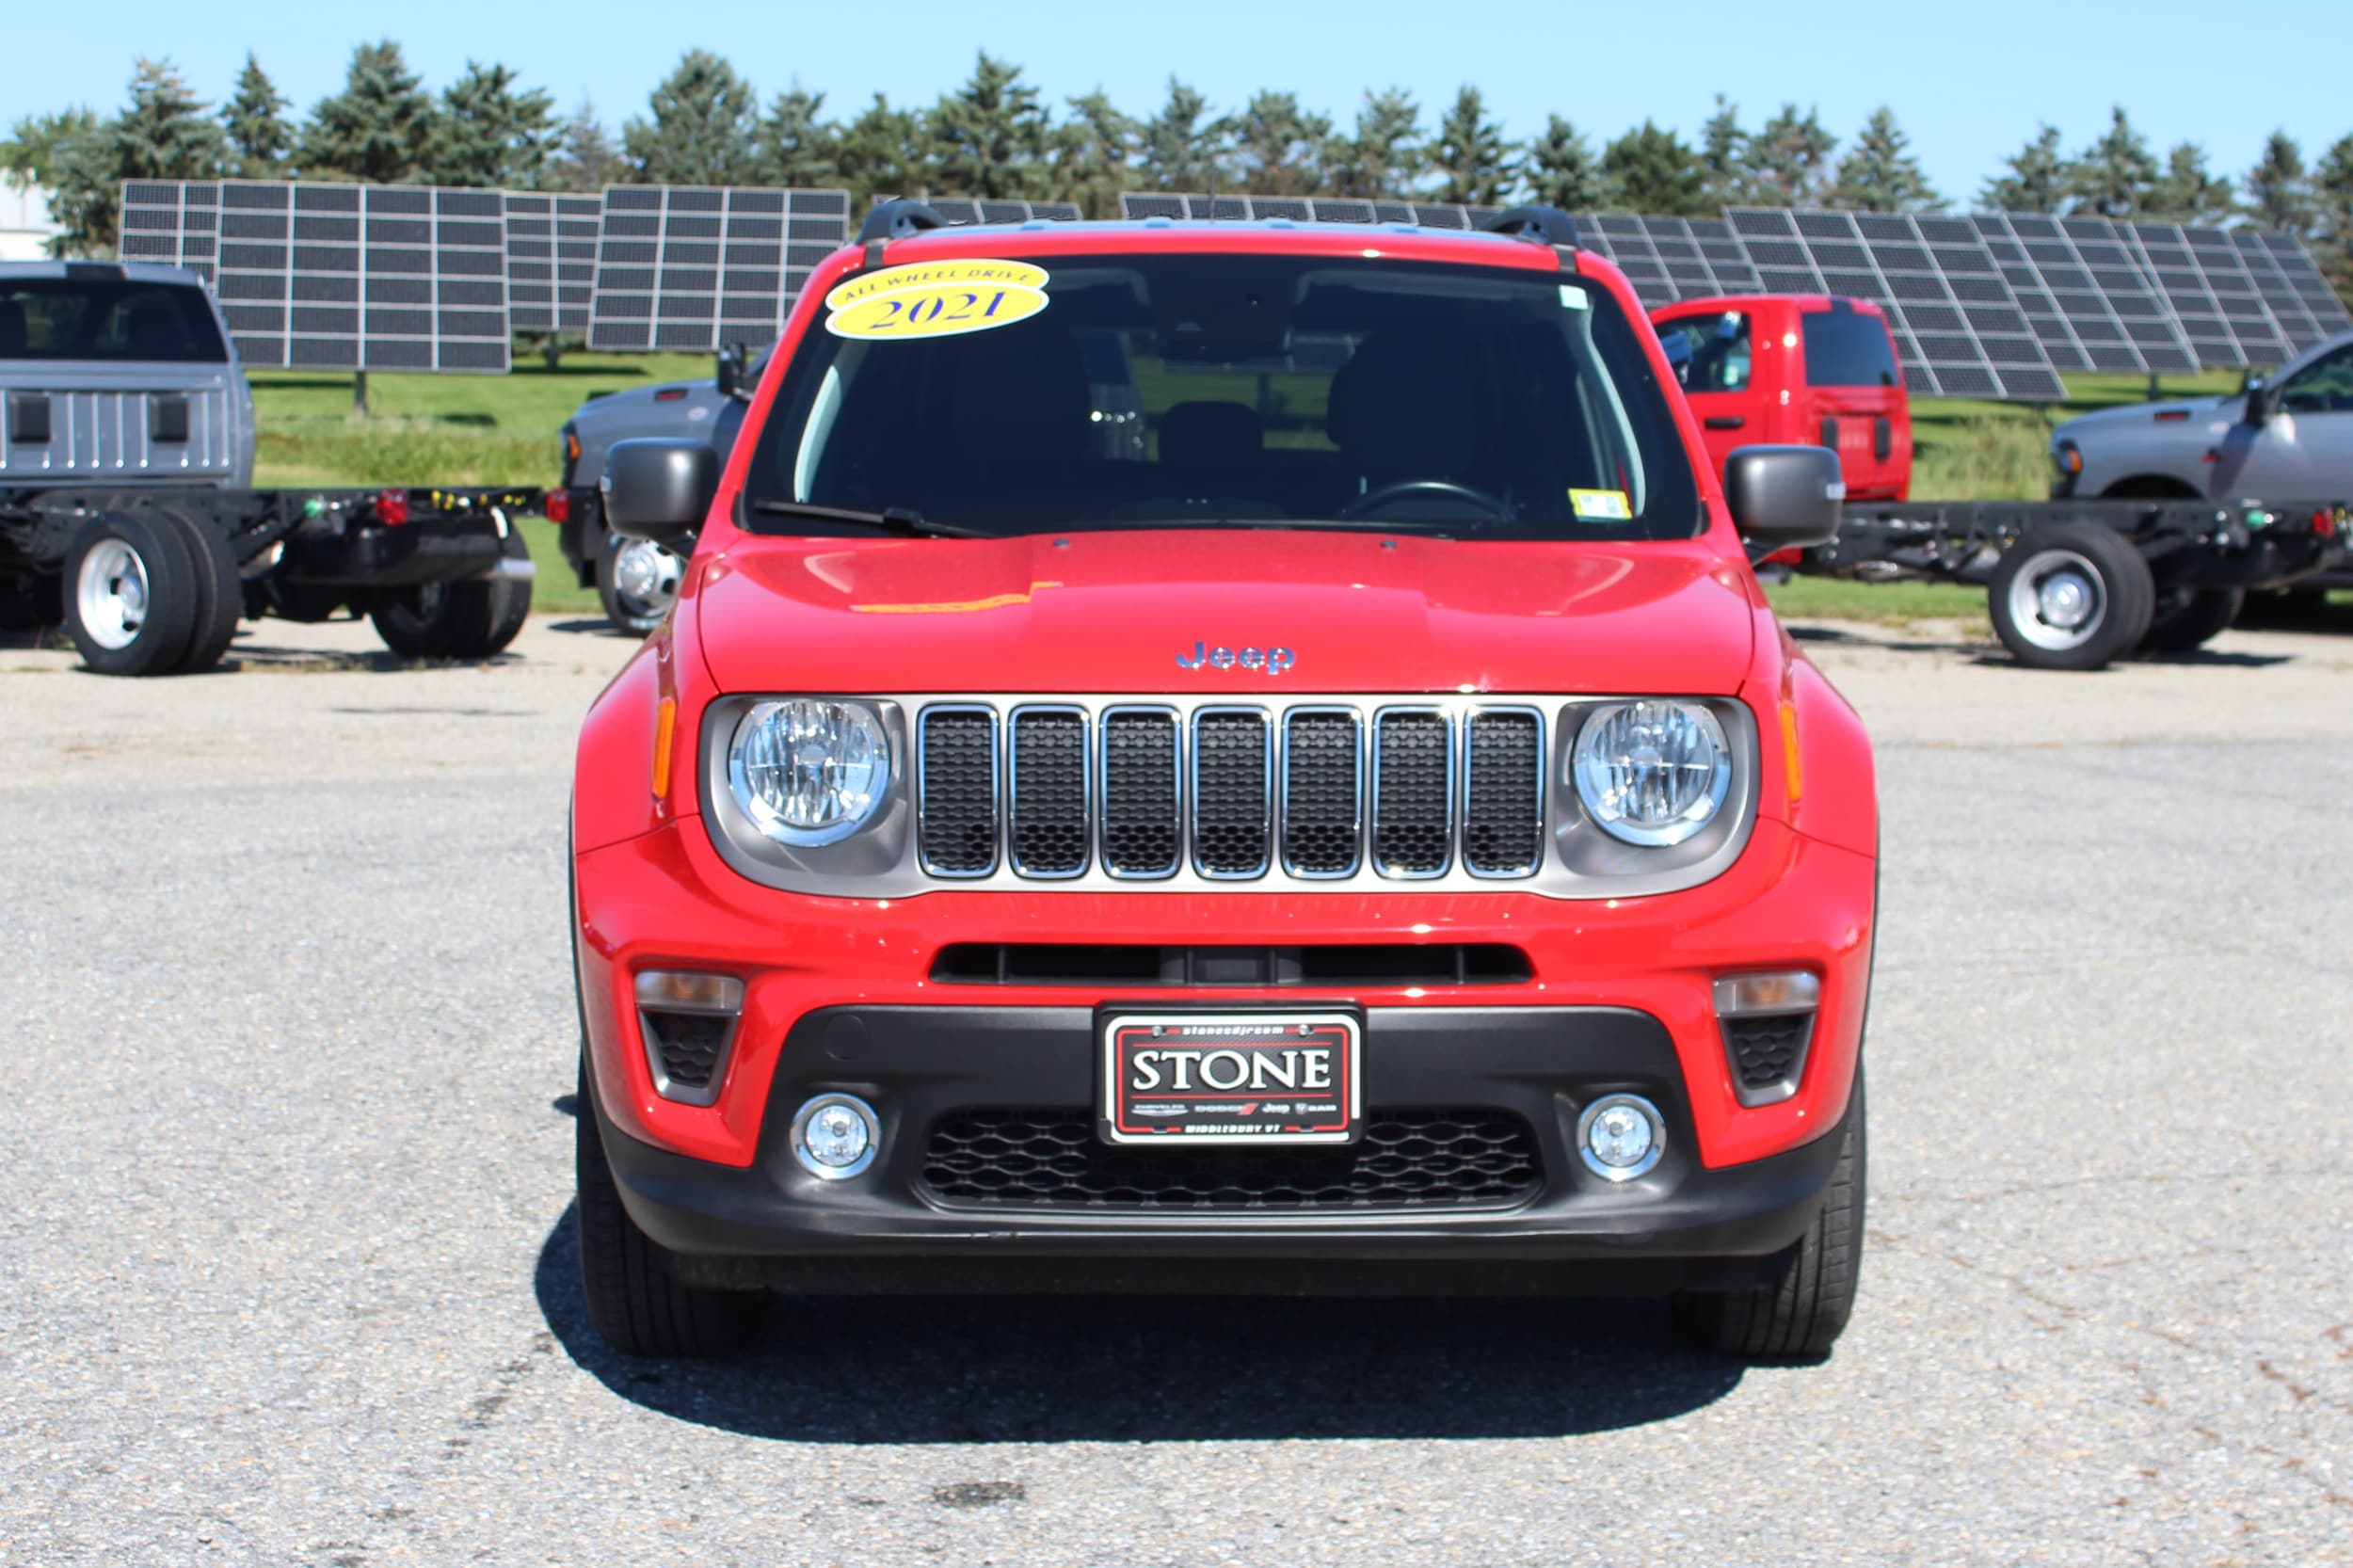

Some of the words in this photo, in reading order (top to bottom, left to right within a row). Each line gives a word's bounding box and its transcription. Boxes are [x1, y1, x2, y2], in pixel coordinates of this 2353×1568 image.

[845, 283, 876, 300] ALL
[887, 270, 957, 286] WHEEL
[968, 269, 1031, 281] DRIVE
[869, 291, 1006, 329] 2021
[1175, 641, 1295, 676] Jeep
[1131, 1049, 1331, 1090] STONE
